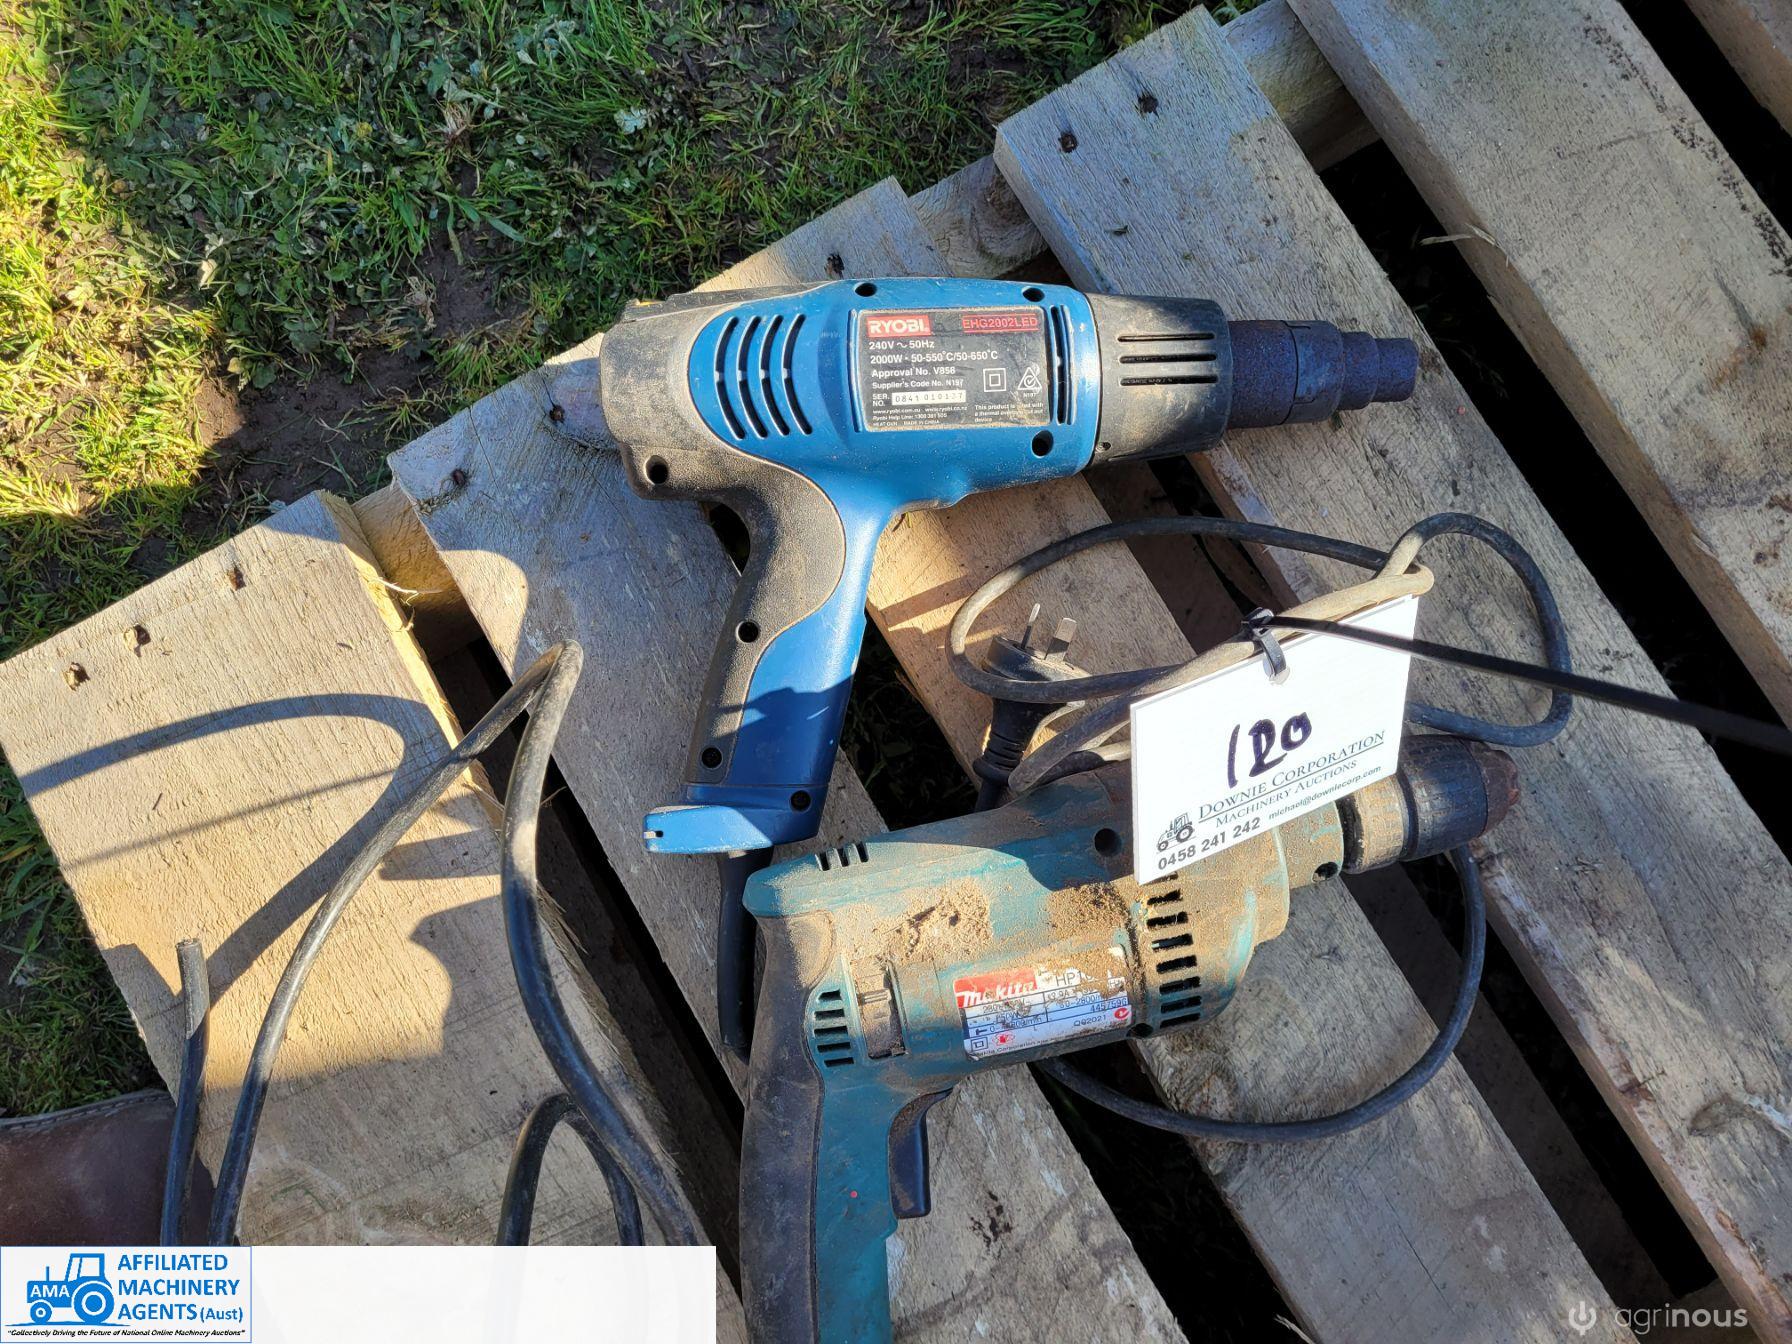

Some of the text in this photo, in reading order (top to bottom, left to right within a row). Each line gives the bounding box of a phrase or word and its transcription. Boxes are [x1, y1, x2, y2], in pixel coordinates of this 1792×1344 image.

[867, 318, 928, 334] RYOBI
[962, 317, 1038, 329] EHG2002LED
[869, 340, 935, 350] 240V 50Hz
[870, 354, 903, 364] 2000W
[871, 368, 913, 379] Approval
[915, 367, 931, 376] No.
[872, 379, 909, 390] Supplier's
[931, 379, 944, 387] No.
[872, 393, 890, 401] SER.
[1227, 711, 1312, 789] 120
[1199, 730, 1386, 819] DOWNIE CORPORATION
[1216, 760, 1357, 828] MACHINERY AUCTIONS
[1269, 765, 1382, 820] michael@downiecorp.com
[1158, 817, 1261, 870] 0458 241 242
